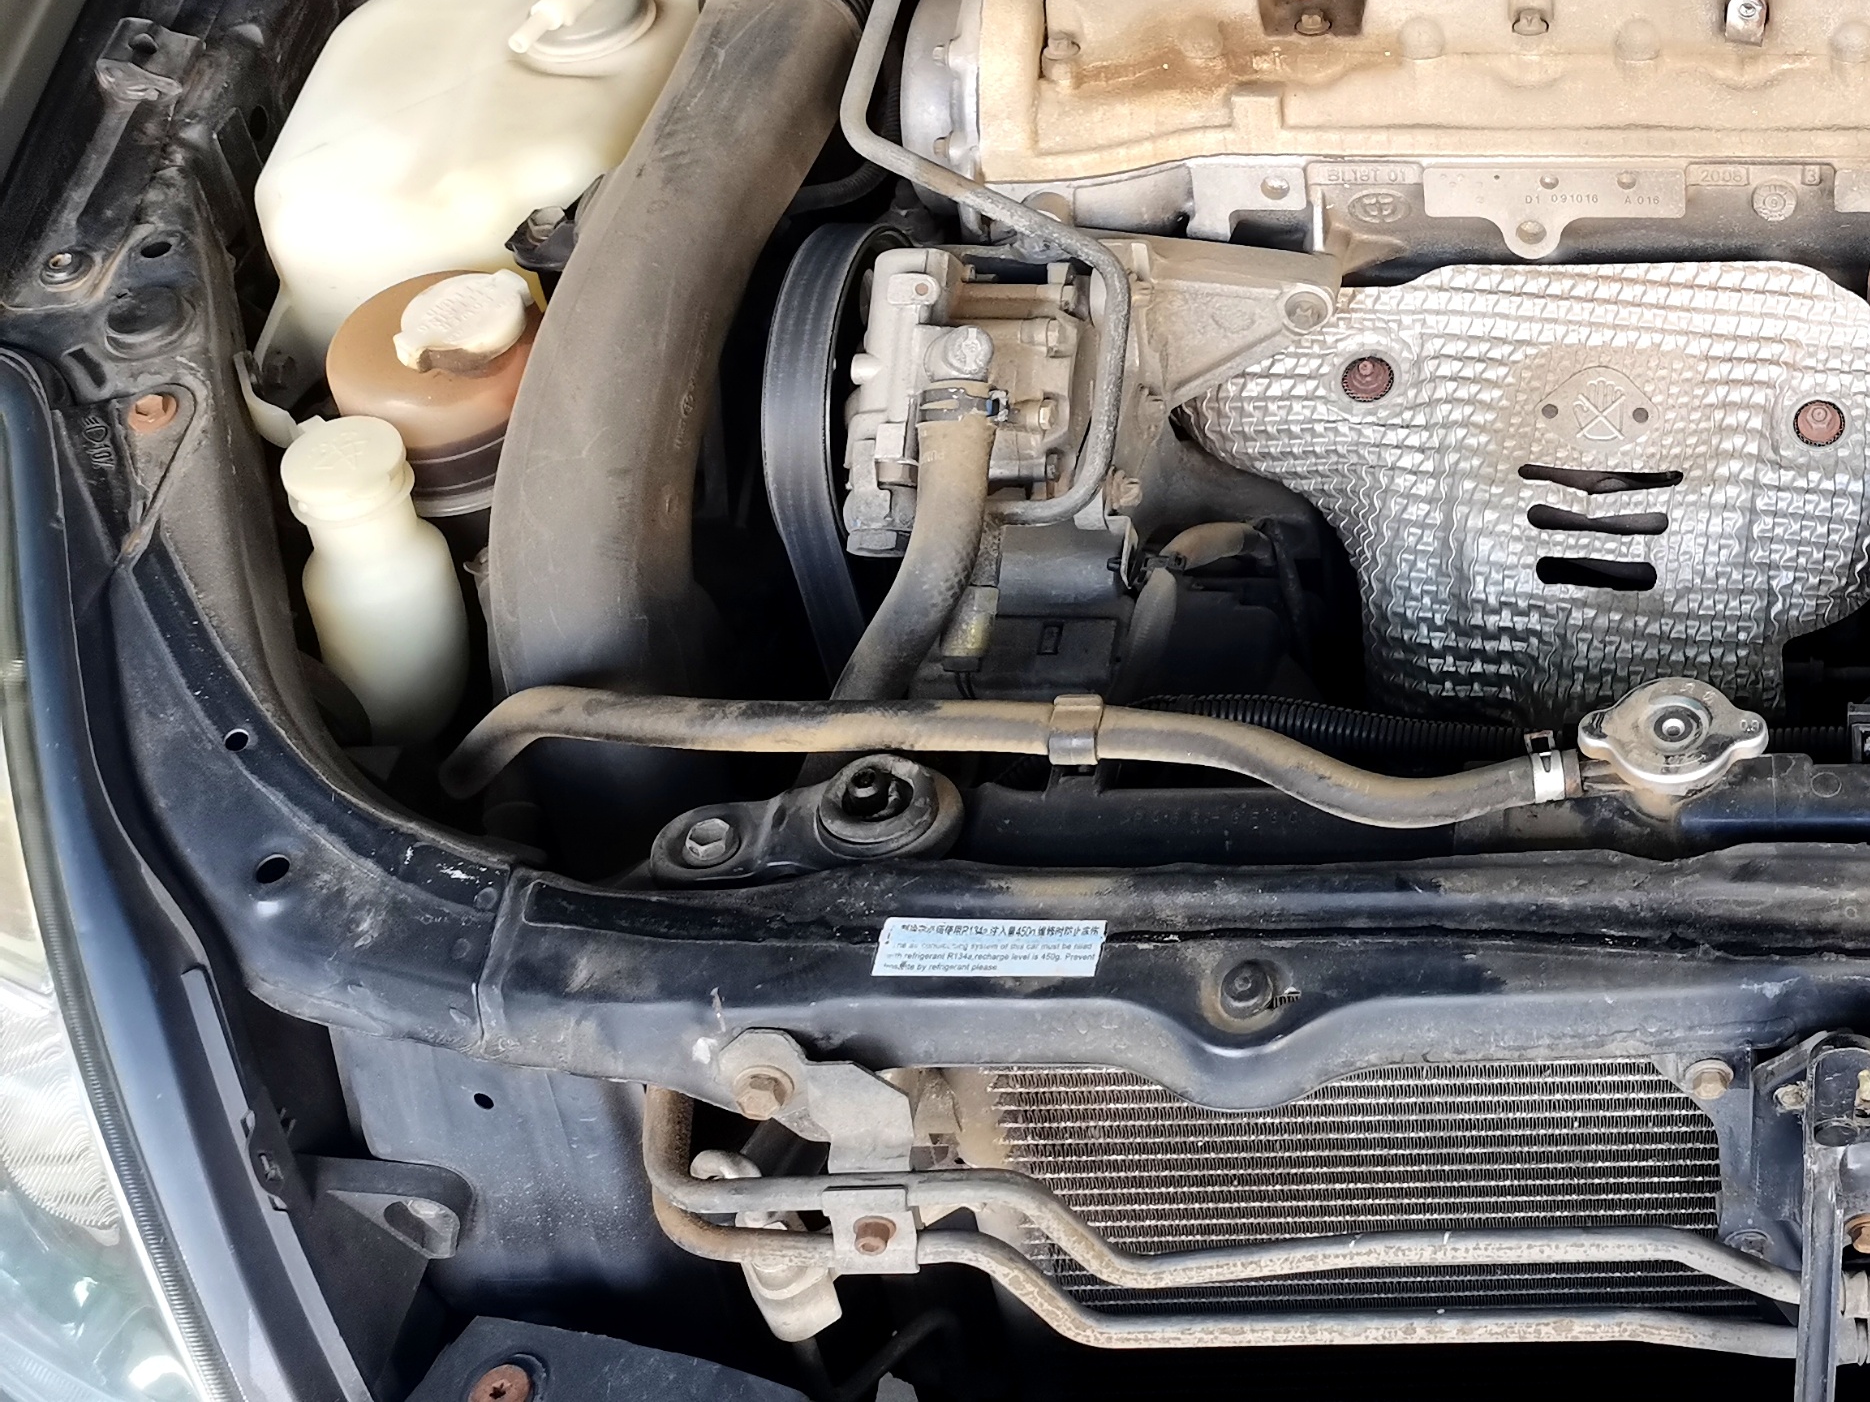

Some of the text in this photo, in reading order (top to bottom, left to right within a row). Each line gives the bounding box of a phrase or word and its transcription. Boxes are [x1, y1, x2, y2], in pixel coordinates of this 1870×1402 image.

[1551, 194, 1599, 204] 091016
[1637, 195, 1660, 205] 016
[904, 952, 945, 963] refrigerant
[1012, 952, 1030, 961] level
[1065, 952, 1095, 961] Prevent
[916, 962, 927, 973] by
[929, 962, 970, 973] refrigerant
